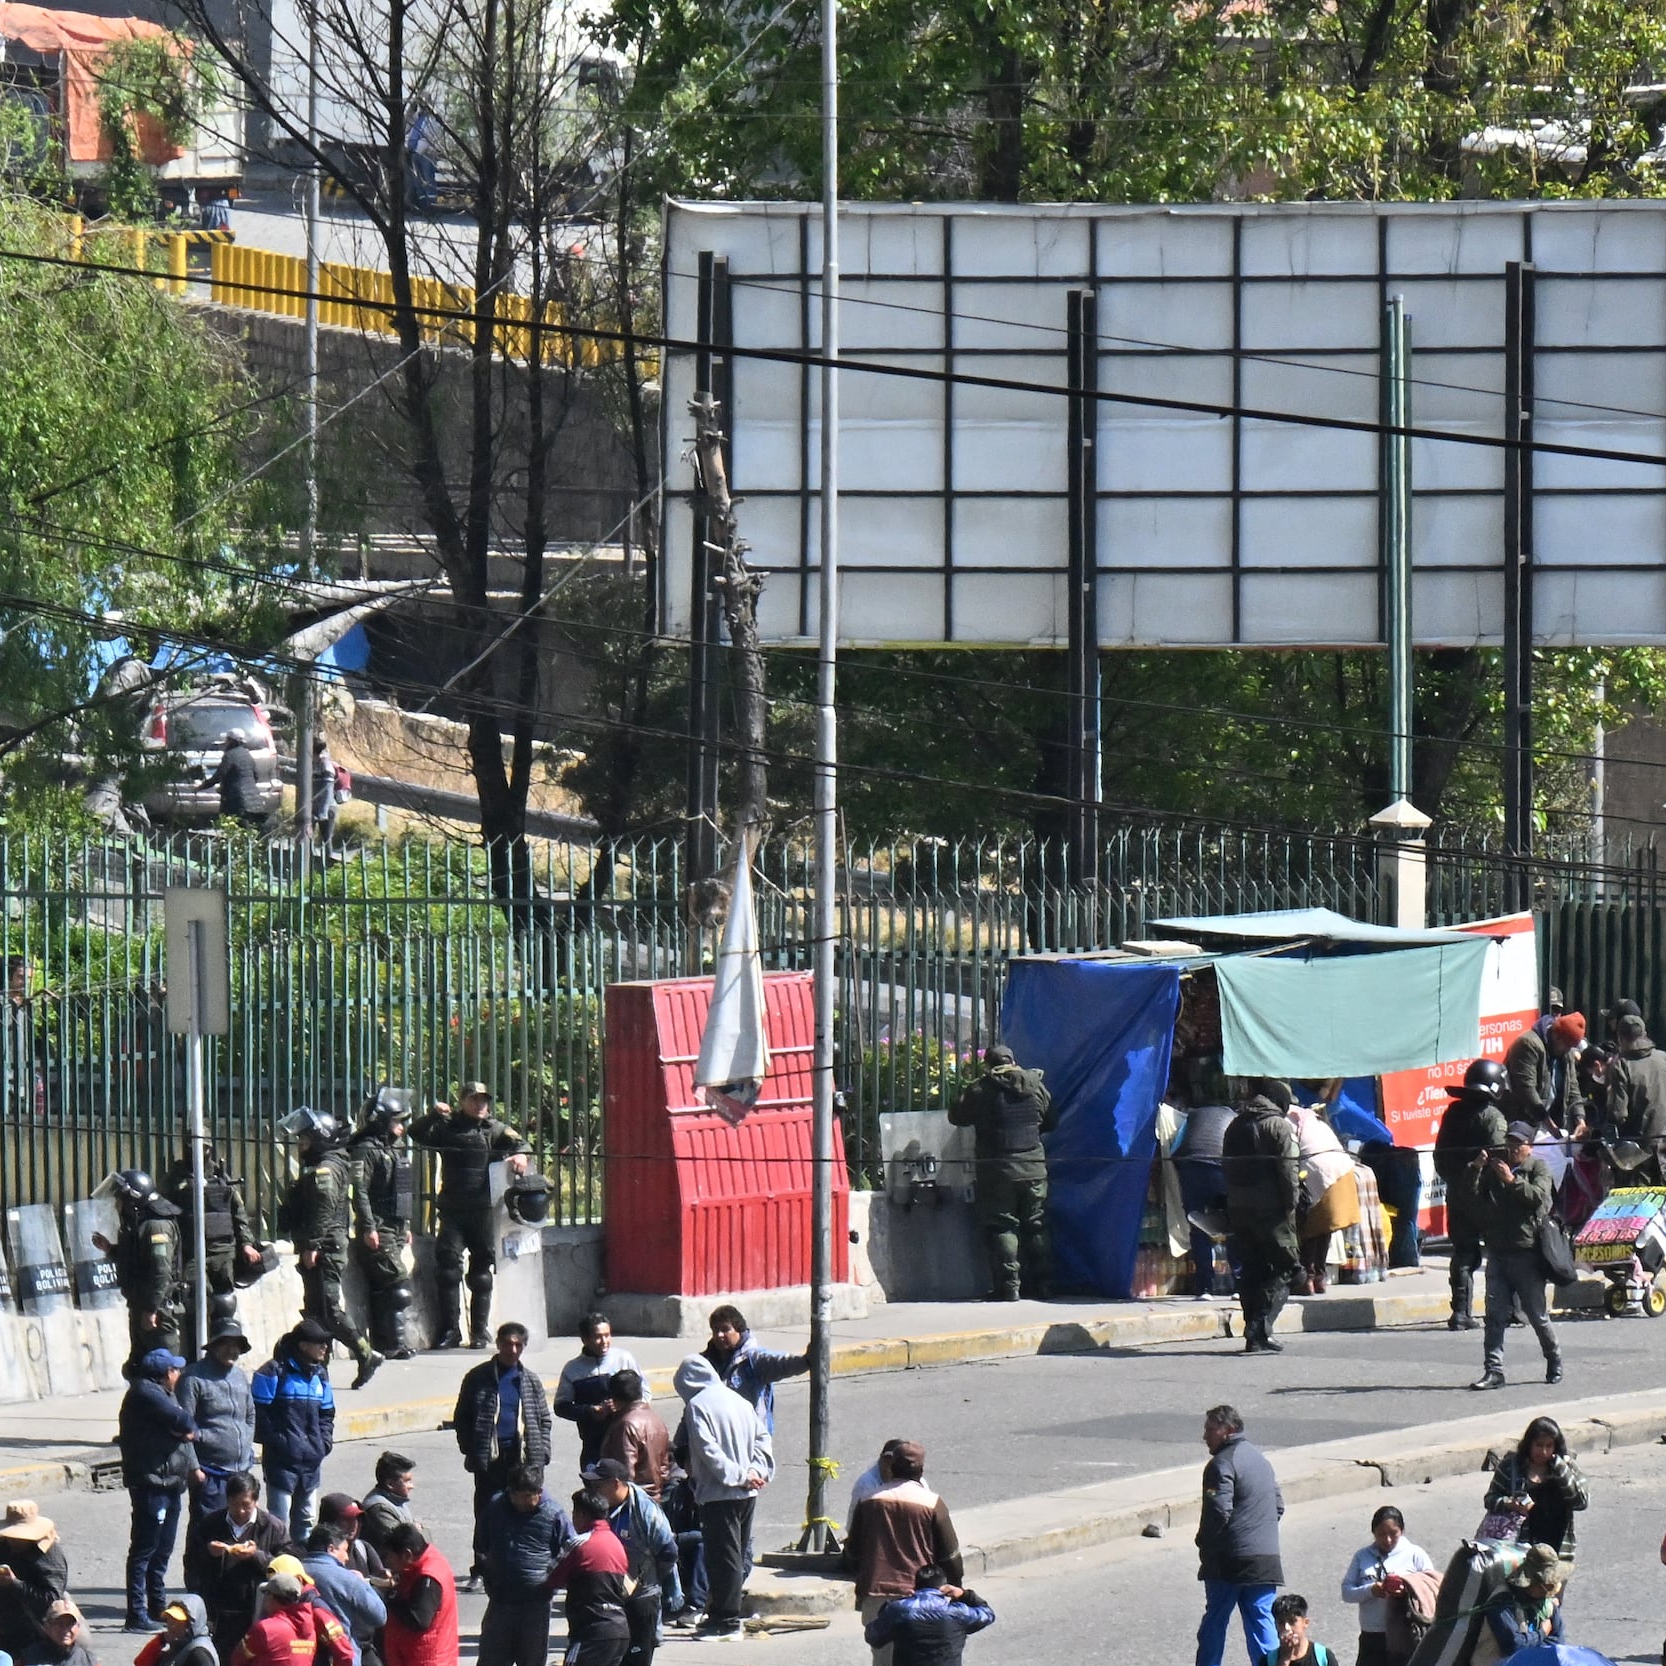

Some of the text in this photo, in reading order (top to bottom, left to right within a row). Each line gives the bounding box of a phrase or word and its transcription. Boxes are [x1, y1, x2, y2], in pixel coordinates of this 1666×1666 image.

[1479, 1018, 1523, 1036] ersonas
[1427, 1066, 1443, 1080] no
[1444, 1064, 1455, 1078] lo
[1391, 1110, 1401, 1123] Si
[1402, 1106, 1432, 1121] tuviste
